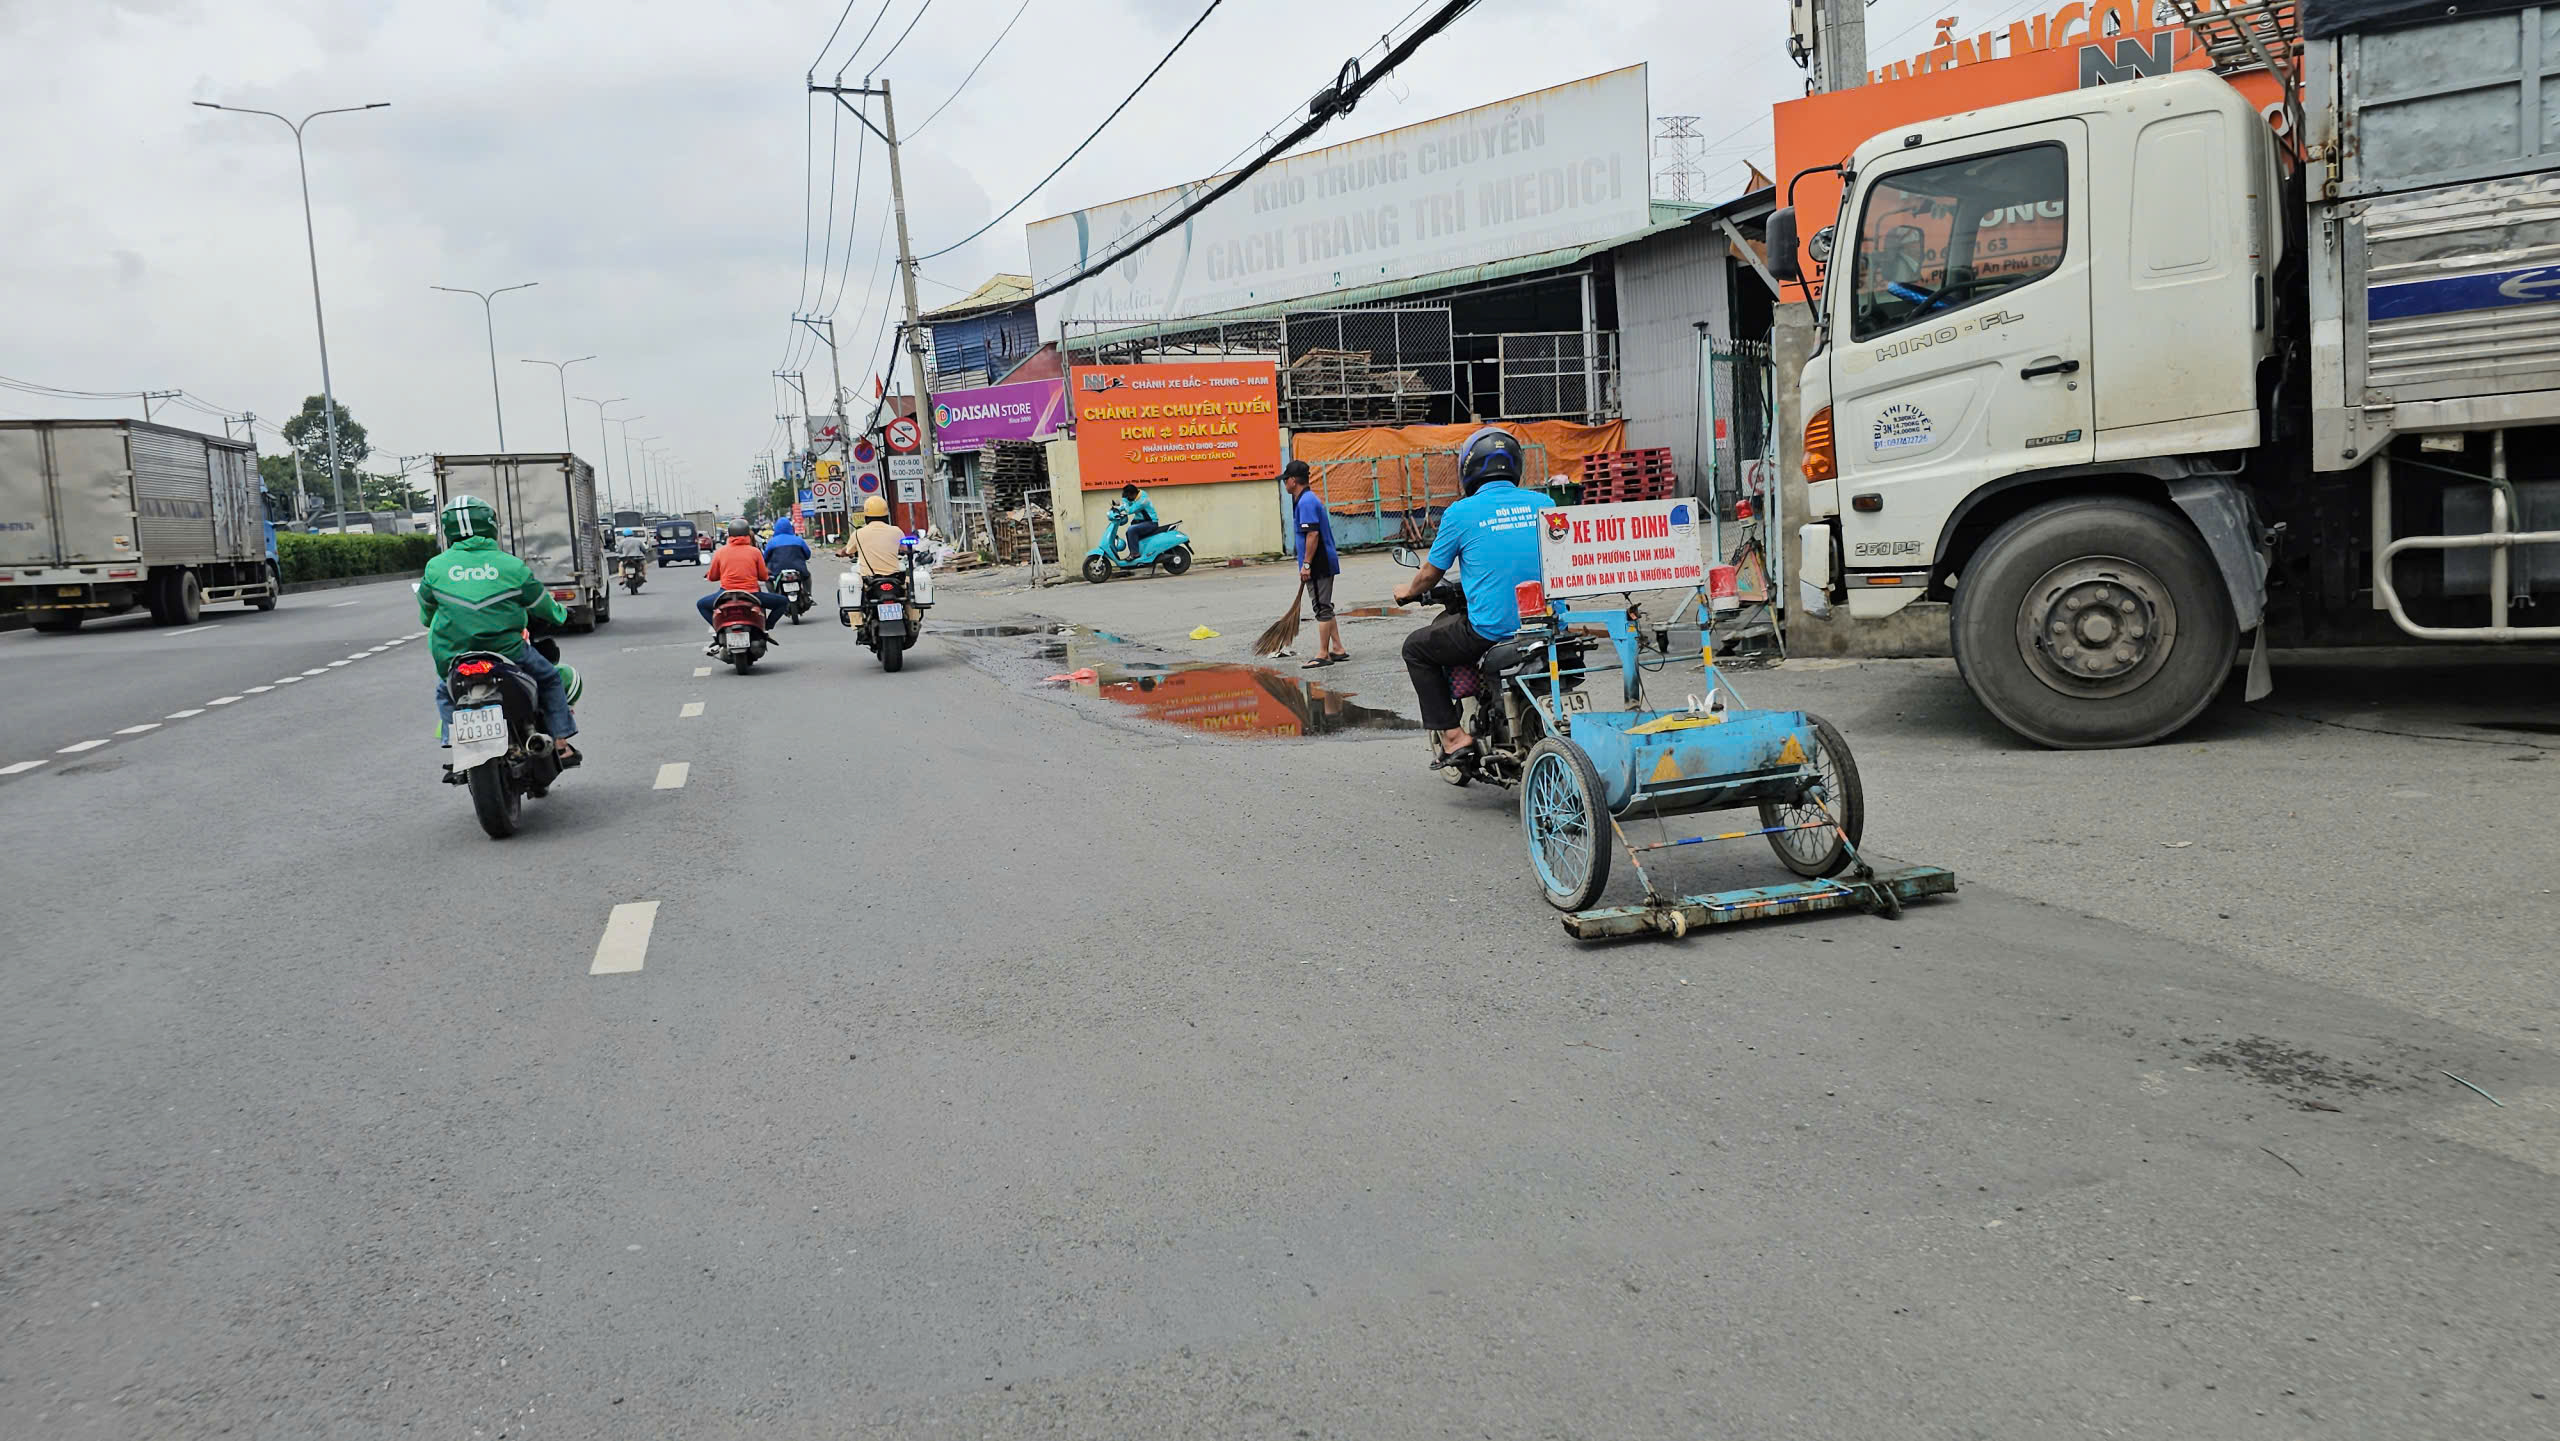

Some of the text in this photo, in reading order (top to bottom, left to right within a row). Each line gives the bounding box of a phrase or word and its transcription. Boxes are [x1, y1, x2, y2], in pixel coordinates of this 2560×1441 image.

[1253, 104, 1546, 215] KHO TRUNG CHUYỂN
[1291, 200, 1400, 267] TRANG
[1415, 178, 1467, 243] TRÍ
[1479, 152, 1622, 225] MEDICI
[2031, 253, 2060, 268] Đôn
[1875, 326, 1958, 362] HINO
[1979, 310, 2024, 331] FL
[1132, 377, 1166, 390] CHÀNH
[1168, 378, 1181, 389] XE
[1181, 375, 1201, 388] BẮC
[1209, 376, 1240, 387] TRUNG
[1247, 376, 1269, 386] NAM
[952, 402, 1031, 422] DAISAN STORE
[1083, 395, 1272, 420] CHÀNH XE CHUYÊN TUYẾN
[1120, 416, 1238, 440] HCM ĐẮK LẮK
[1572, 514, 1669, 544] XE HÚT ĐINH
[1571, 547, 1675, 567] ĐOÀN PHƯỜNG LINH XUÂN
[1855, 541, 1921, 556] 260 PS
[448, 562, 499, 581] Grab
[1550, 576, 1563, 589] XIN
[1586, 572, 1597, 586] ƠN
[458, 722, 502, 742] 203.89
